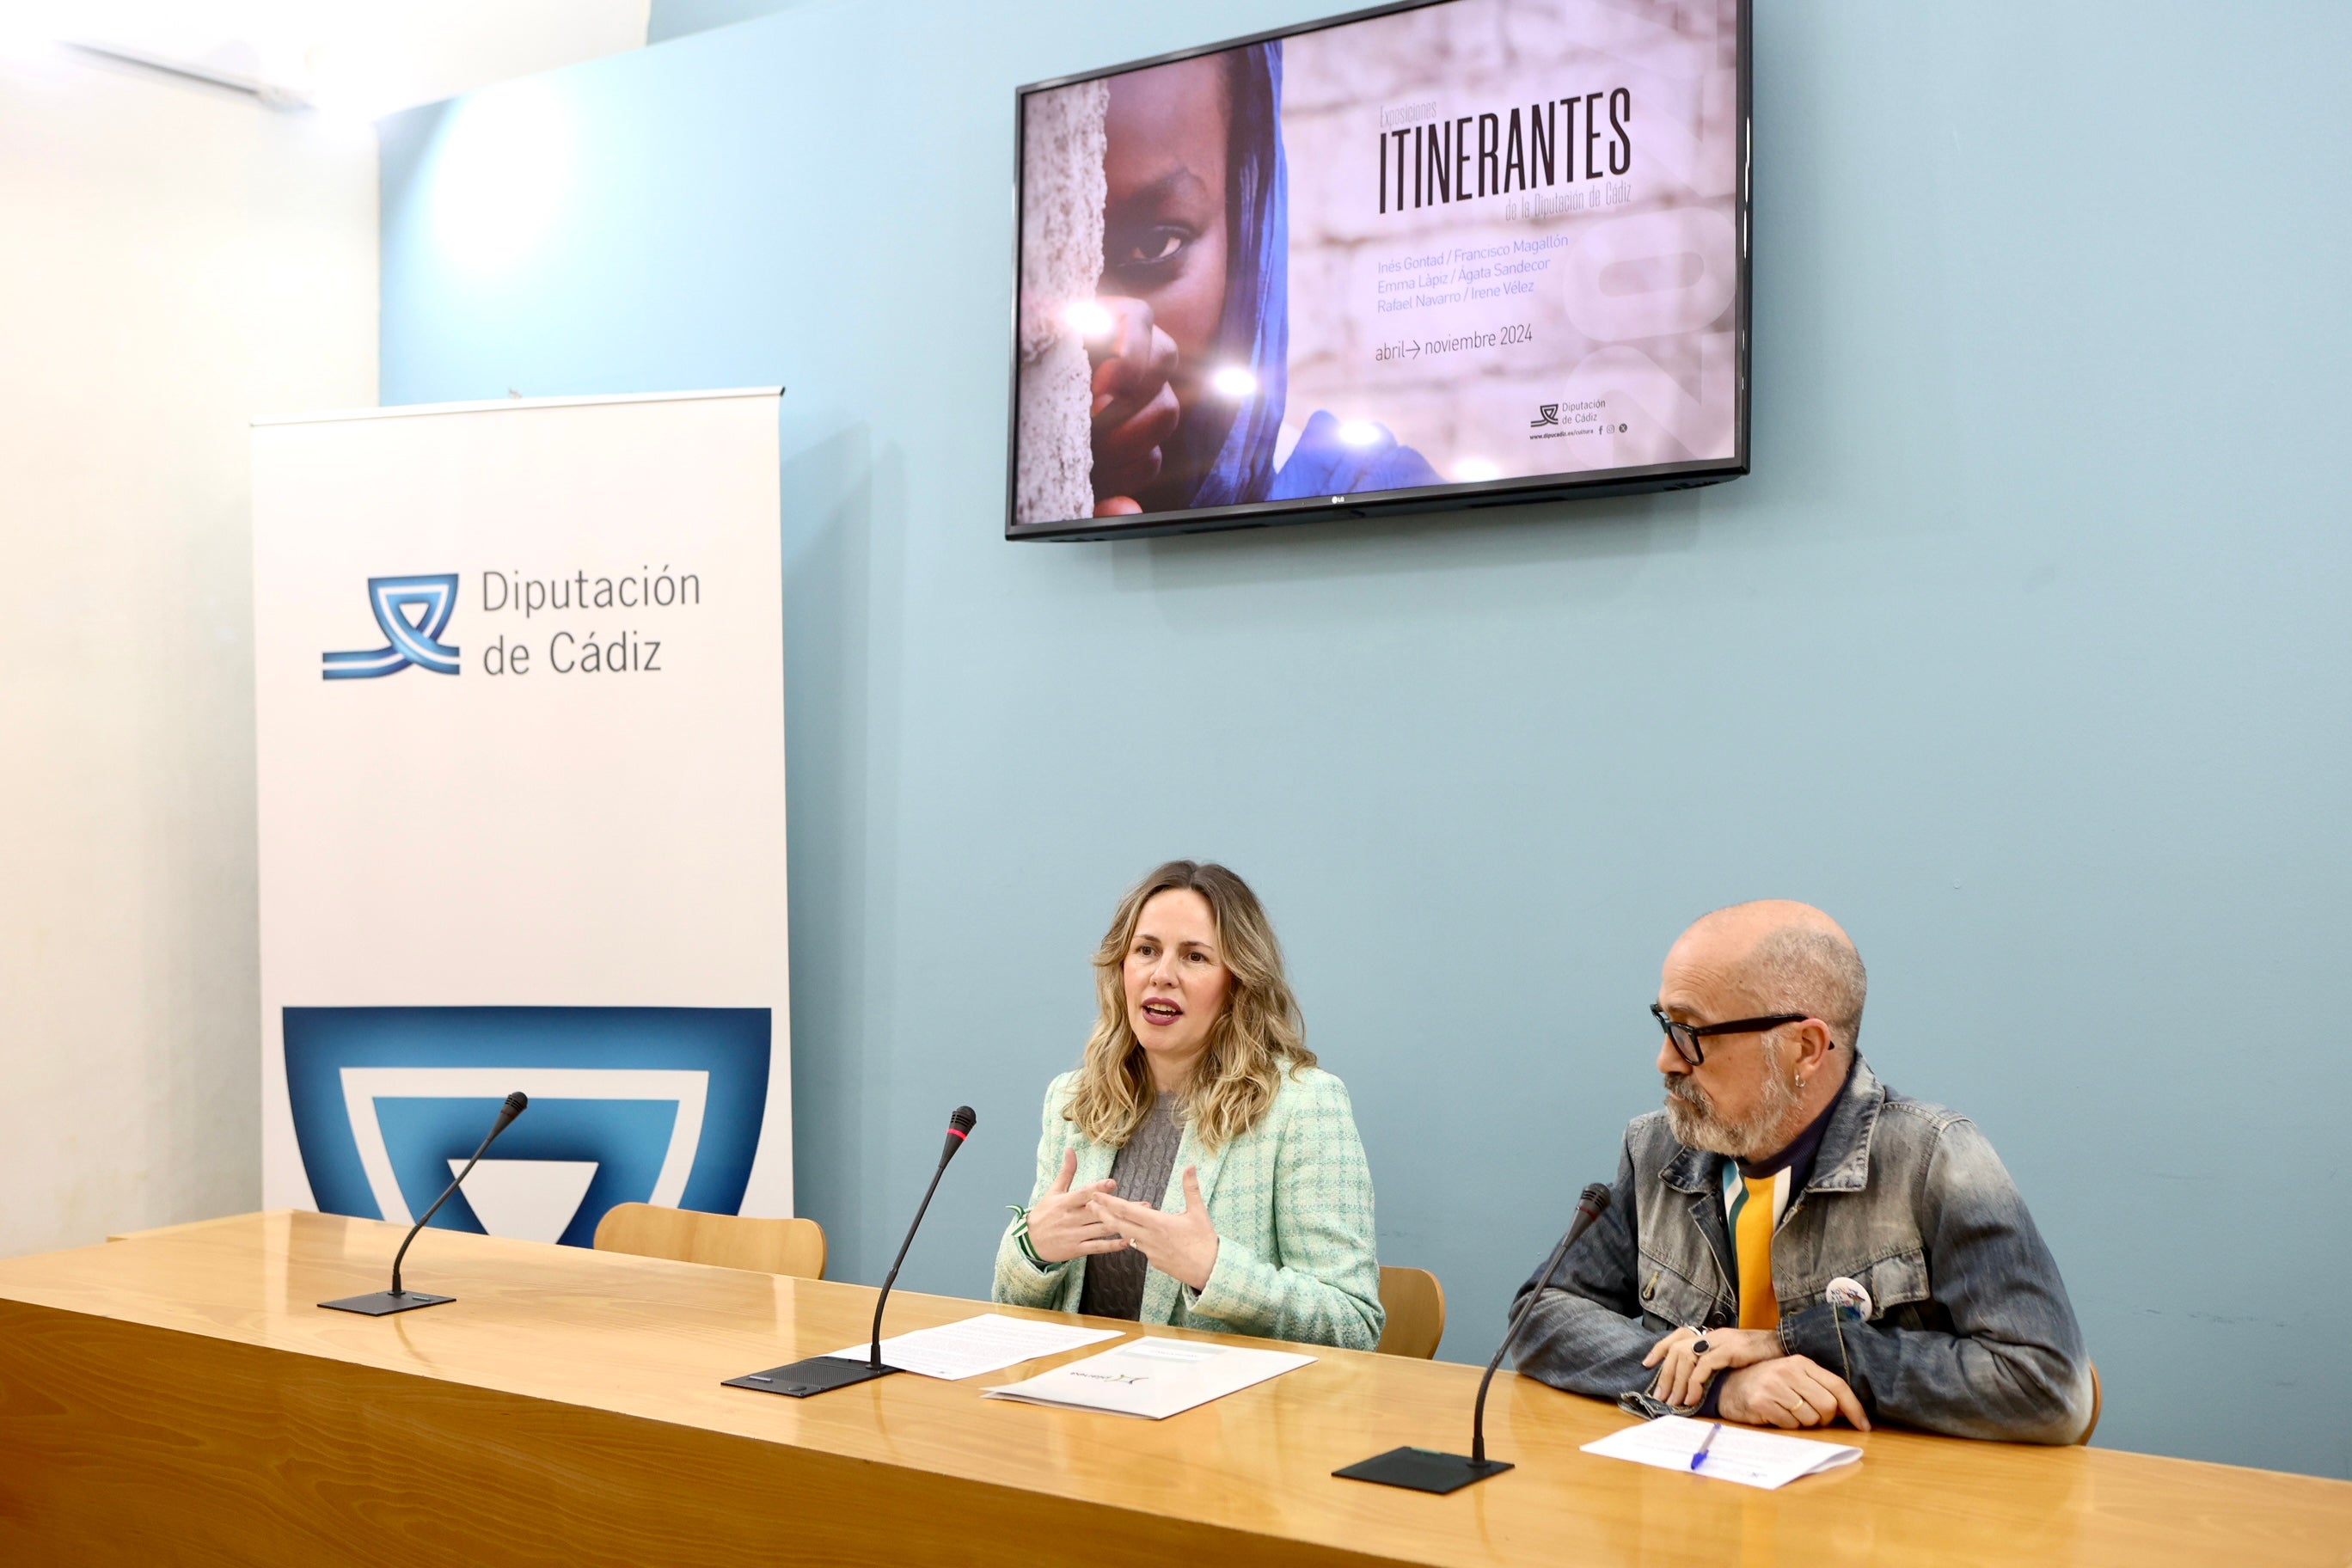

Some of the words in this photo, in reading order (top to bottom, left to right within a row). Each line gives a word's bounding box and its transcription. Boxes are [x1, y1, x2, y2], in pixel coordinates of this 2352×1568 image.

[1380, 101, 1436, 128] Exposiciones
[1379, 88, 1631, 214] ITINERANTES
[1505, 199, 1516, 221] de
[1522, 195, 1530, 219] la
[1534, 190, 1584, 218] Diputación
[1589, 187, 1601, 208] de
[1606, 181, 1632, 205] Cádiz
[1378, 260, 1402, 274] Inés
[1404, 253, 1444, 270] Gontad
[1455, 242, 1510, 262] Francisco
[1513, 234, 1569, 255] Magallón
[1378, 279, 1415, 294] Emma
[1458, 265, 1491, 284] Ágata
[1494, 258, 1551, 277] Sandecor
[1377, 296, 1412, 313] Rafael
[1416, 291, 1461, 308] Navarro
[1471, 285, 1501, 300] Irene
[1503, 280, 1534, 295] Vélez
[1375, 340, 1406, 361] abril
[1425, 331, 1497, 355] noviembre
[1501, 323, 1533, 346] 2024
[1562, 399, 1606, 413] Diputación
[1562, 416, 1572, 425] de
[1575, 413, 1597, 424] Cádiz
[483, 565, 700, 618] Diputación
[483, 634, 530, 676] de
[549, 631, 662, 674] Cádiz
